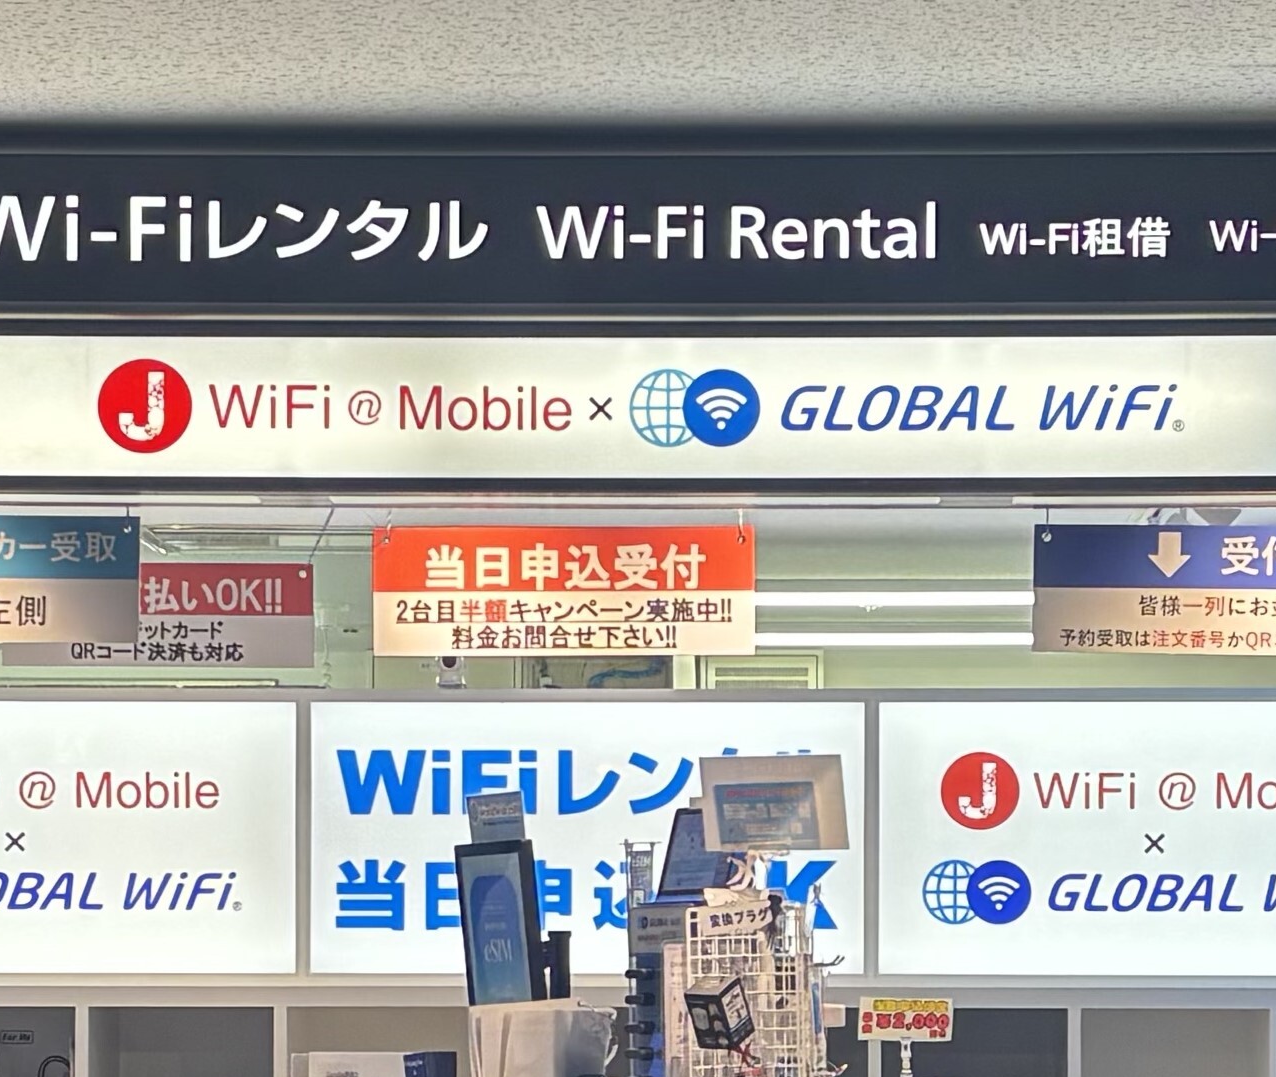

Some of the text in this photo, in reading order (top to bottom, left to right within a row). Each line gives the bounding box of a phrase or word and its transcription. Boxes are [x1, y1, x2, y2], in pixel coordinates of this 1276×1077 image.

[536, 201, 937, 261] Wi-Fi Rental
[979, 216, 1171, 258] Wi-Fi租借
[209, 383, 331, 430] WiFi
[398, 383, 571, 432] Mobile
[780, 384, 1015, 432] GLOBAL
[425, 543, 707, 591] 当日申込受付
[140, 576, 282, 614] 払いOK!!
[139, 621, 224, 640] ットカード
[71, 641, 244, 662] QRコード決済も対応
[76, 770, 220, 810] Mobile
[1033, 771, 1136, 810] WiFi
[1048, 872, 1244, 913] GLOBAL
